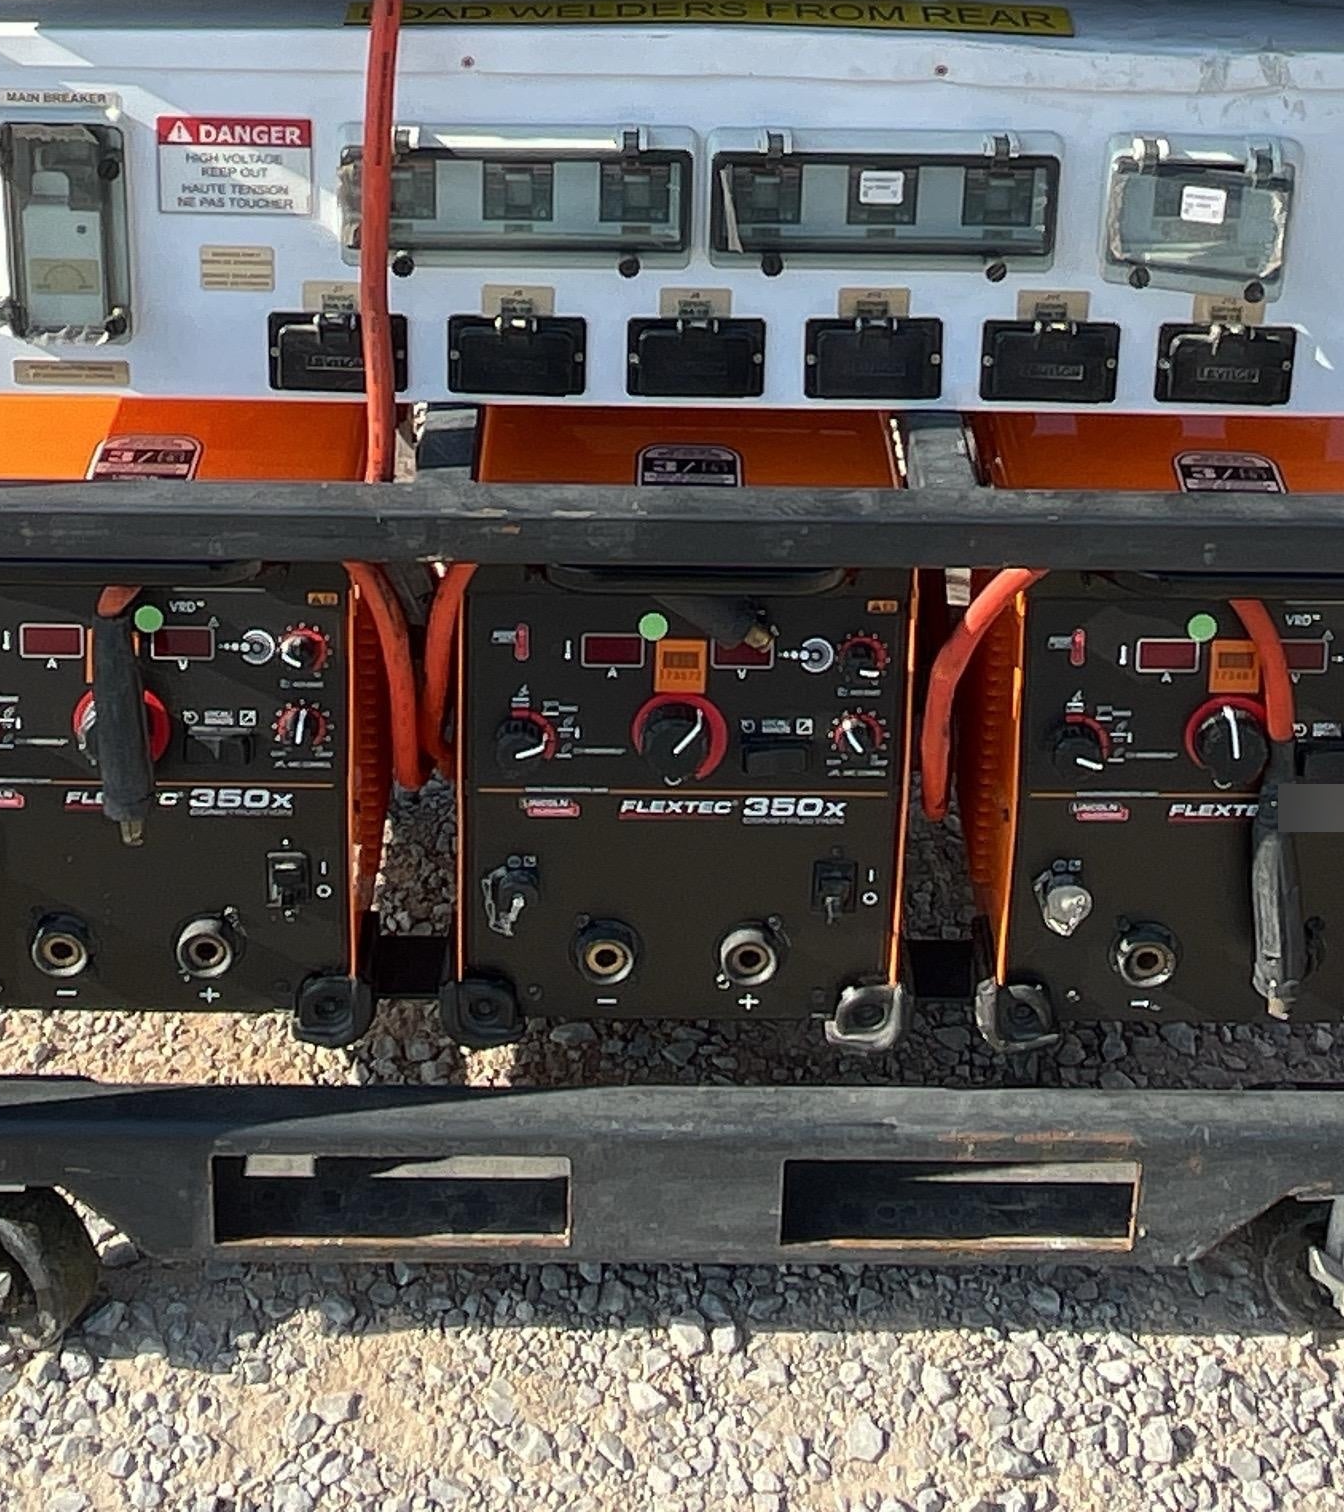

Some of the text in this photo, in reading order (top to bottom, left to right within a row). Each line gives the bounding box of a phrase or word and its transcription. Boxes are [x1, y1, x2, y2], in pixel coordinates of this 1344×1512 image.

[507, 0, 748, 20] WELDERS
[763, 2, 906, 23] FROM
[920, 5, 1058, 28] REAR
[6, 92, 106, 105] MAIN BREAKER
[199, 123, 302, 145] DANGER
[186, 153, 283, 165] HIGH VOLTAGE
[201, 166, 268, 178] KEEP OUT
[182, 183, 289, 196] HAUTE TENSION
[178, 196, 294, 210] NE PAS TOUCHER
[46, 657, 58, 669] A
[178, 658, 188, 671] V
[607, 667, 618, 679] A
[1161, 672, 1173, 684] A
[620, 800, 733, 815] FLEXTEC
[1169, 803, 1258, 818] FLEXTE
